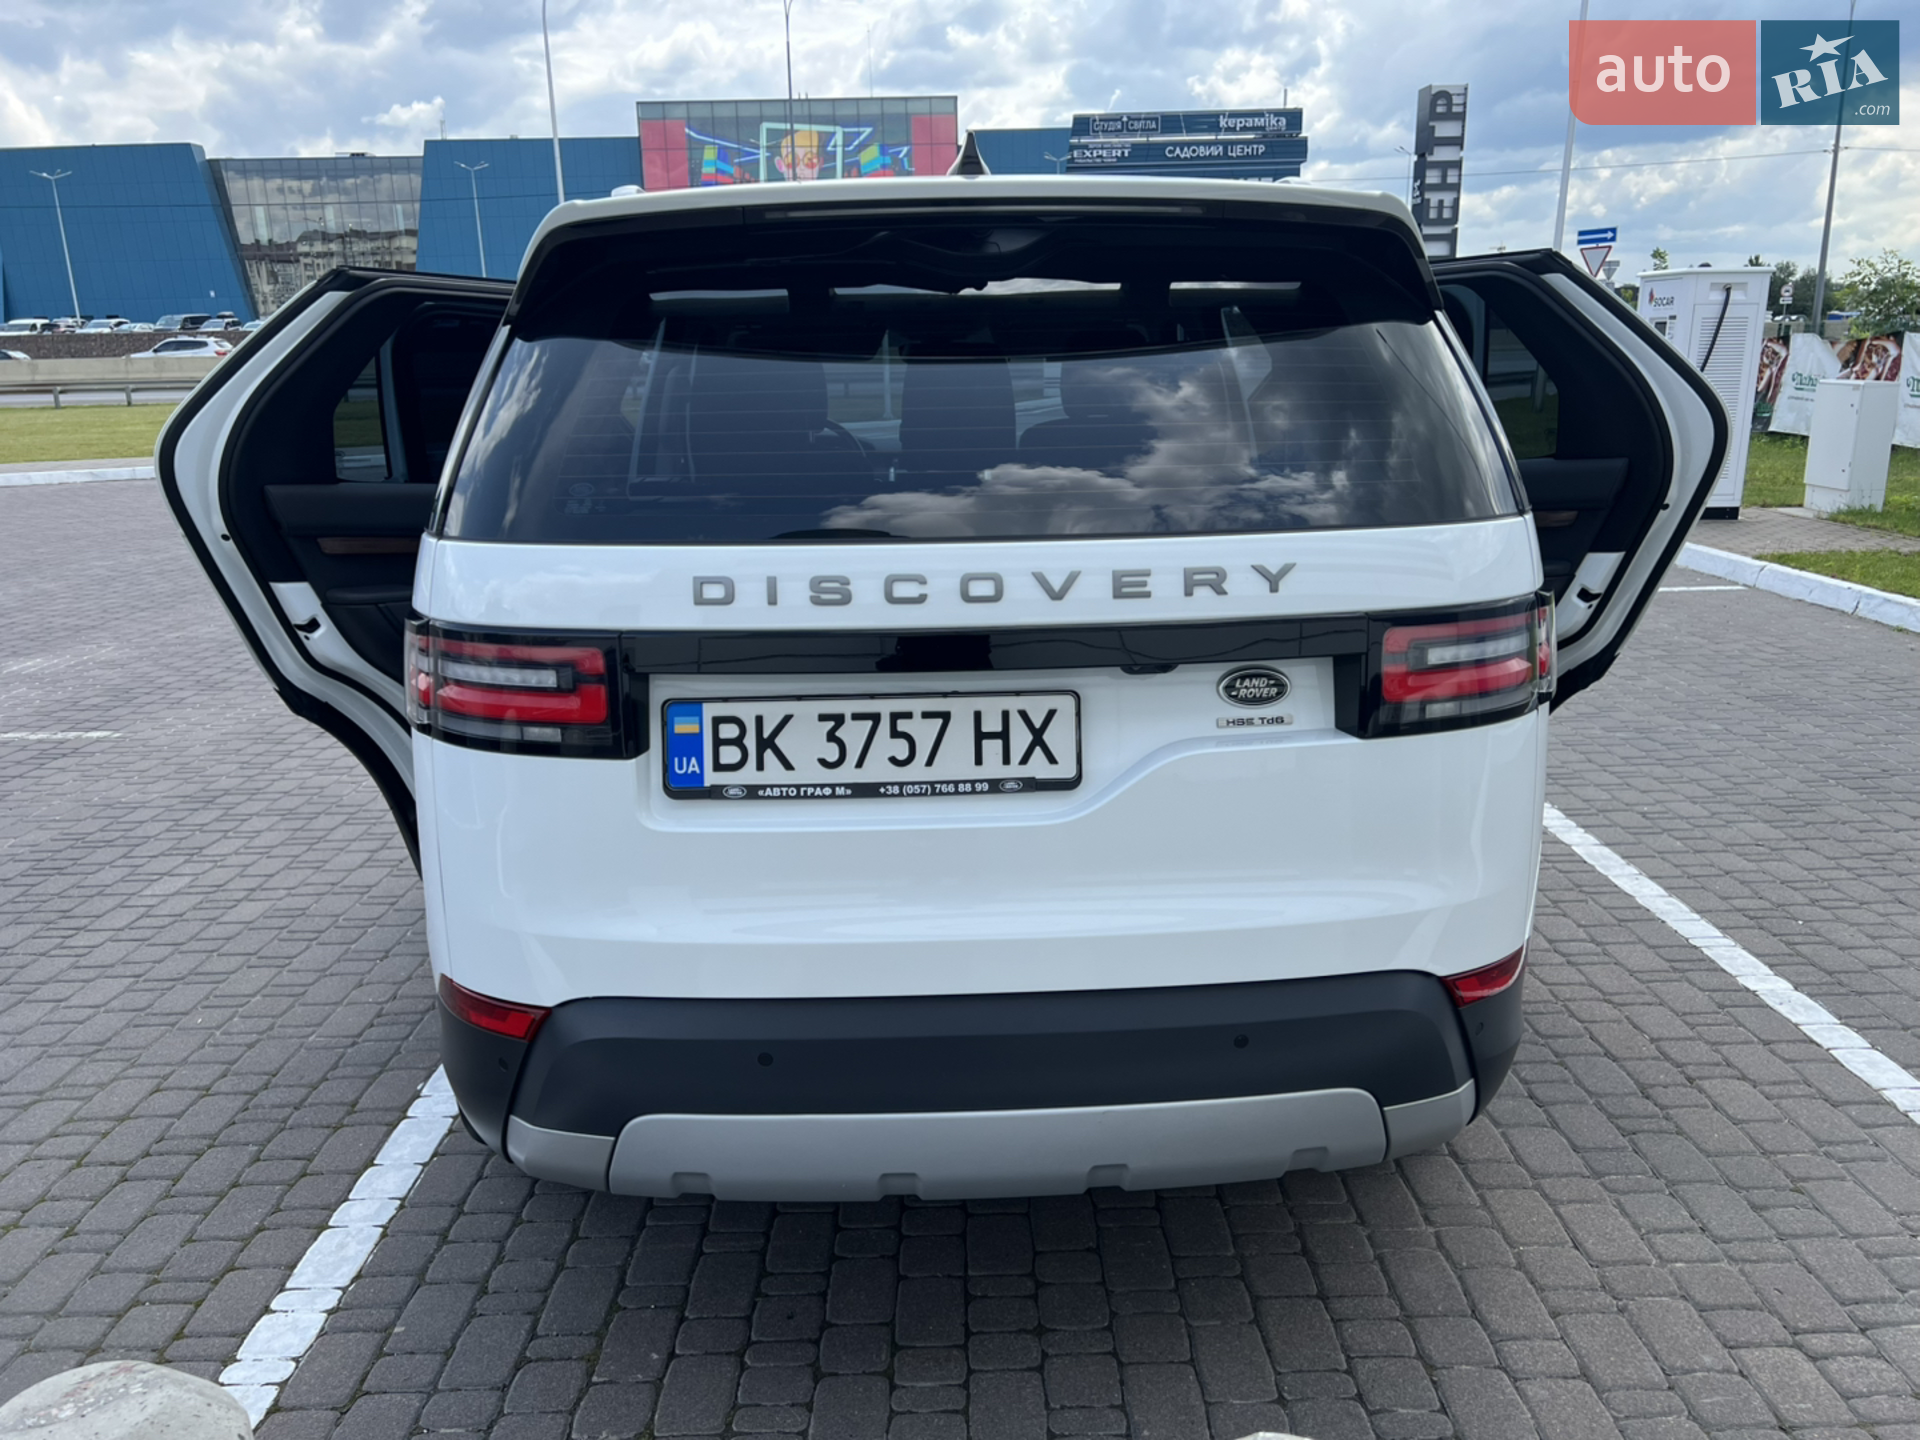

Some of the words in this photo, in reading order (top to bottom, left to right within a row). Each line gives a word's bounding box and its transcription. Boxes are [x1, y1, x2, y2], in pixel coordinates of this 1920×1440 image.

[1073, 148, 1132, 158] EXPERT
[1165, 144, 1223, 159] САДОВИЙ
[1227, 144, 1266, 158] ЦЕНТР
[1653, 296, 1675, 307] SOCAR
[692, 562, 1297, 606] DISCOVERY
[1235, 678, 1268, 688] LAND
[1237, 687, 1278, 698] ROVER
[1226, 718, 1255, 727] HSE
[1258, 716, 1285, 725] Td6
[711, 714, 796, 773] BK
[816, 710, 952, 769] 3757
[973, 708, 1060, 766] HX
[674, 757, 700, 775] UA
[758, 787, 797, 797] «АВТО
[800, 786, 833, 797] ГРАФ
[879, 785, 900, 795] +38
[902, 784, 932, 796] (057)
[934, 783, 955, 793] 766
[958, 783, 972, 792] 88
[975, 782, 989, 792] 99
